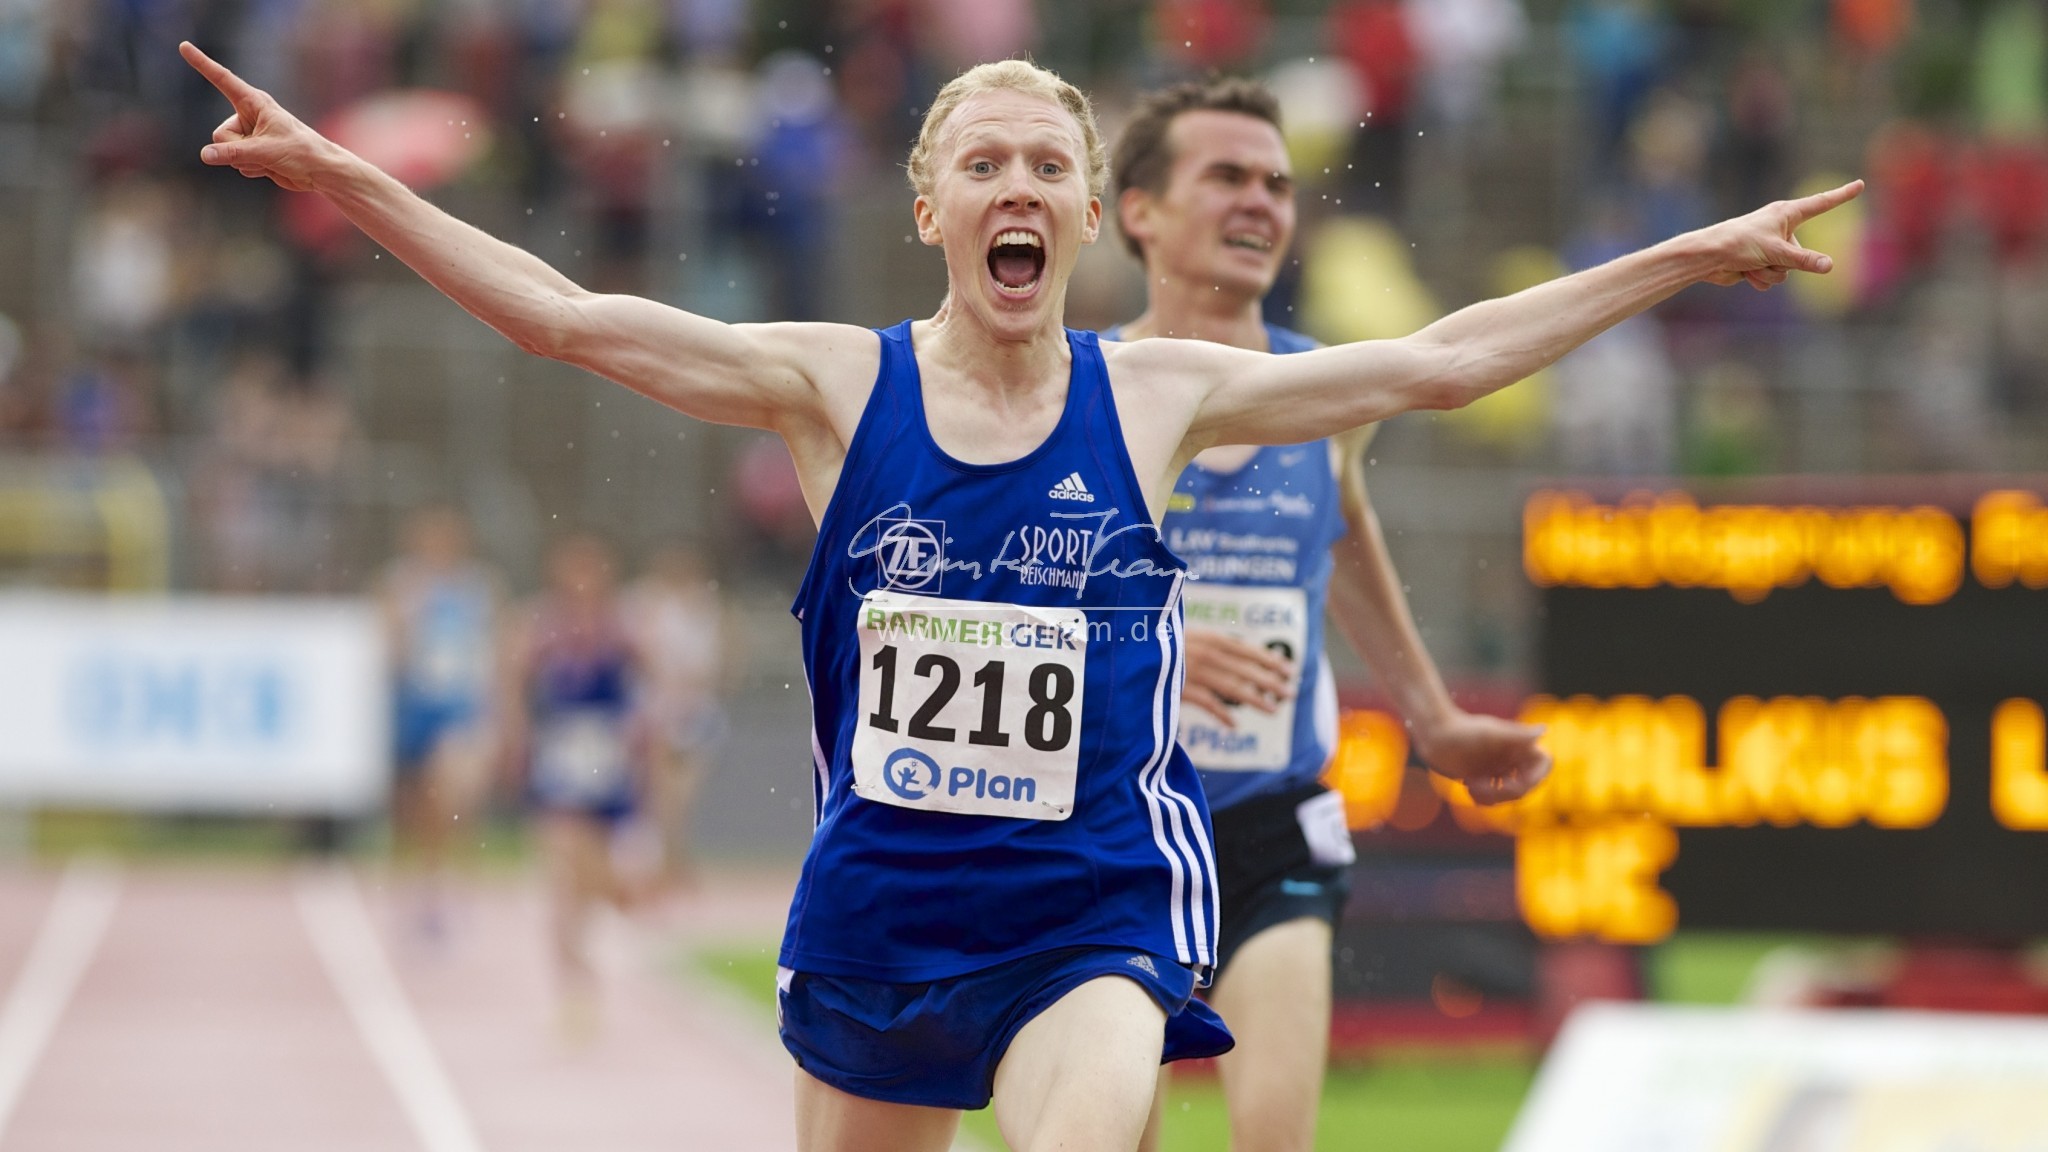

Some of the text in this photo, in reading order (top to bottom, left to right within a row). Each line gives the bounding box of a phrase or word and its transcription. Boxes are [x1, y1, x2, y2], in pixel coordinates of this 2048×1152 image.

[1048, 489, 1095, 503] adidas
[1020, 525, 1093, 567] SPORT
[1019, 565, 1087, 591] REISCHMANN
[866, 607, 1077, 651] BARMER GEK
[868, 644, 1075, 752] 1218
[948, 766, 1037, 803] Plan
